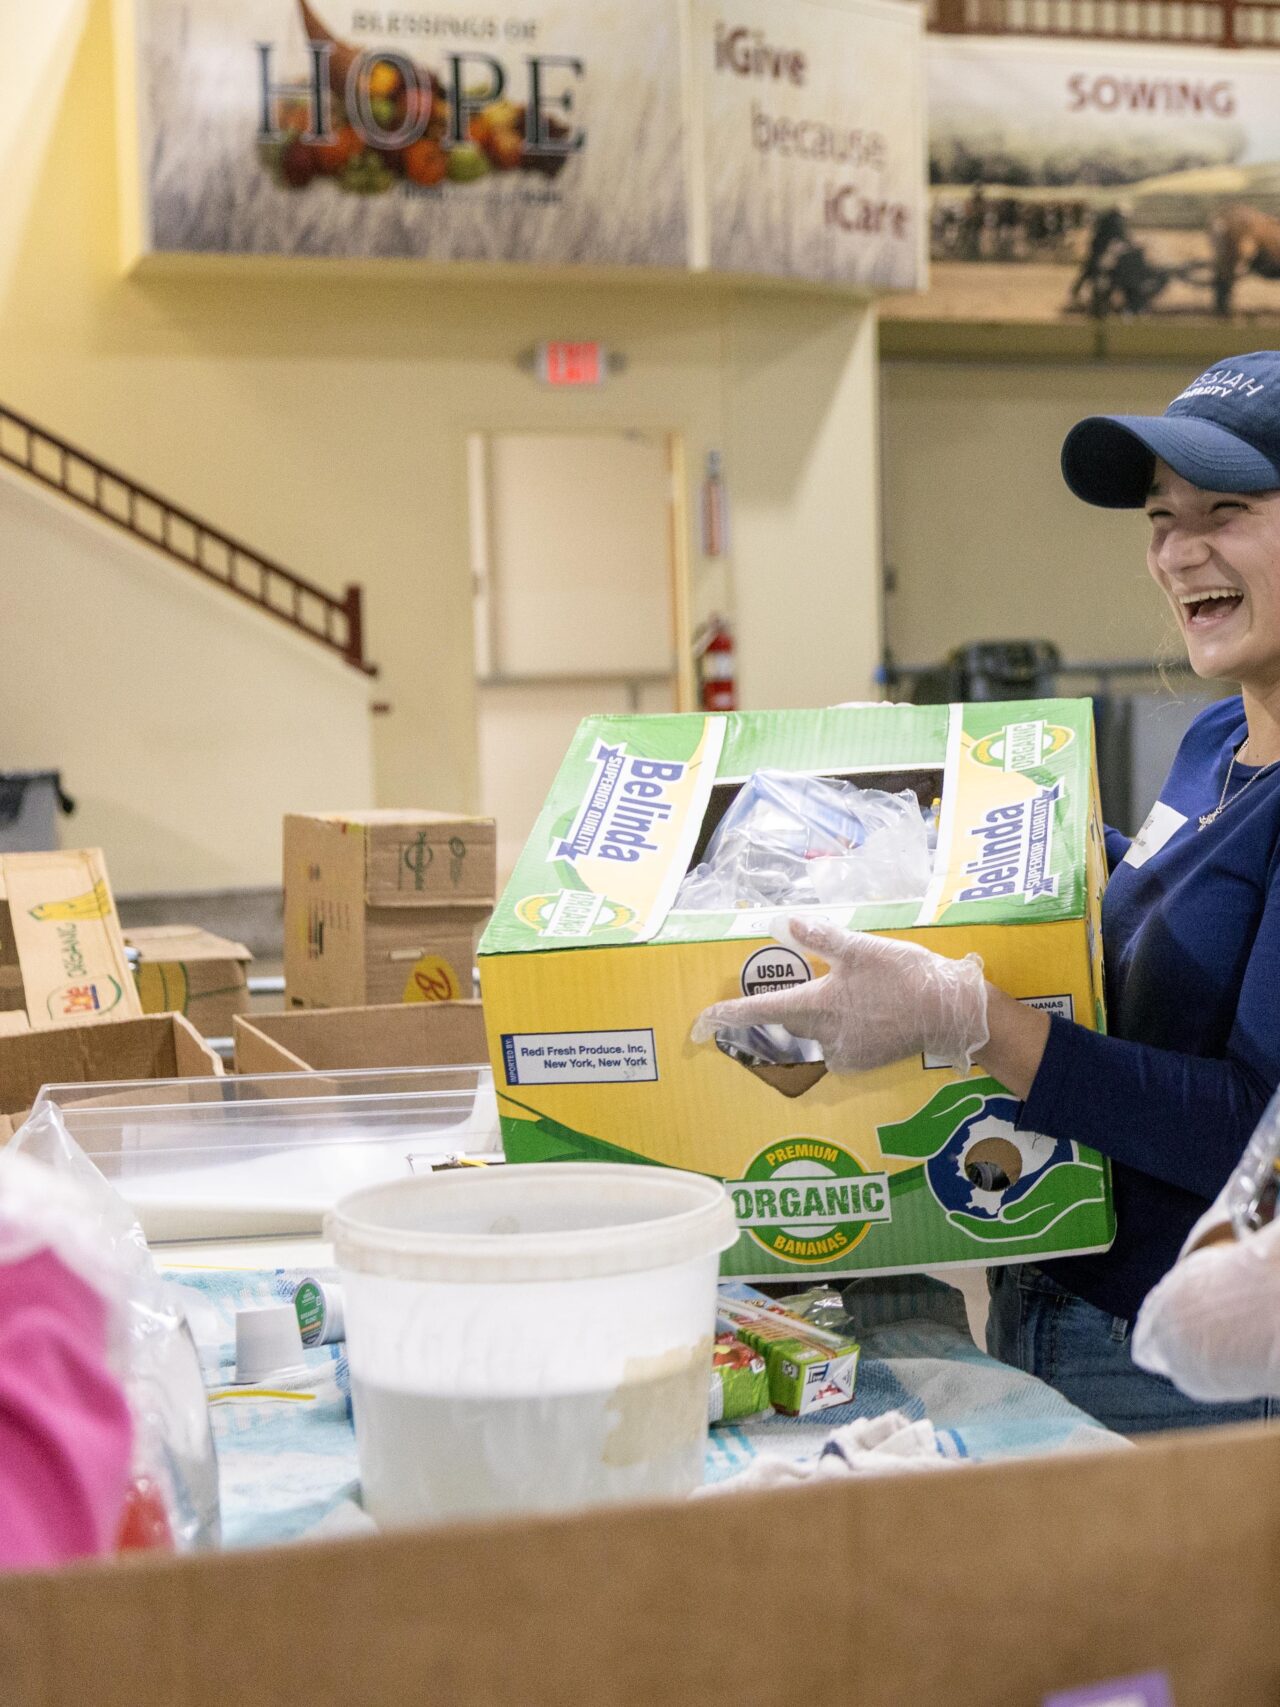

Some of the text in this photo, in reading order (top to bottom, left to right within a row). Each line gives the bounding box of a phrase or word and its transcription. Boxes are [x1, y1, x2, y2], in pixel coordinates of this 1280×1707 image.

[714, 20, 806, 88] iGive
[255, 40, 585, 154] HOPE
[1066, 72, 1237, 118] SOWING
[751, 98, 888, 171] because
[823, 180, 911, 239] iCare
[1190, 369, 1265, 398] SSIAH
[1011, 724, 1037, 769] ORGANIC
[572, 755, 624, 855] SUPERIOR QUALITY
[598, 759, 684, 862] Belinda
[959, 801, 1025, 901] Belinda
[1026, 799, 1050, 890] SUPERIOR QUALITY
[753, 983, 800, 995] ORGA
[757, 963, 795, 979] USDA
[1027, 1000, 1064, 1010] NANAS
[506, 1050, 517, 1083] IMPORTED
[520, 1046, 545, 1057] Redi
[547, 1046, 577, 1056] Fresh
[544, 1056, 648, 1069] New York, New York
[765, 1143, 839, 1167] PREMIUM
[731, 1182, 885, 1219] ORGANIC
[773, 1231, 848, 1256] BANANAS
